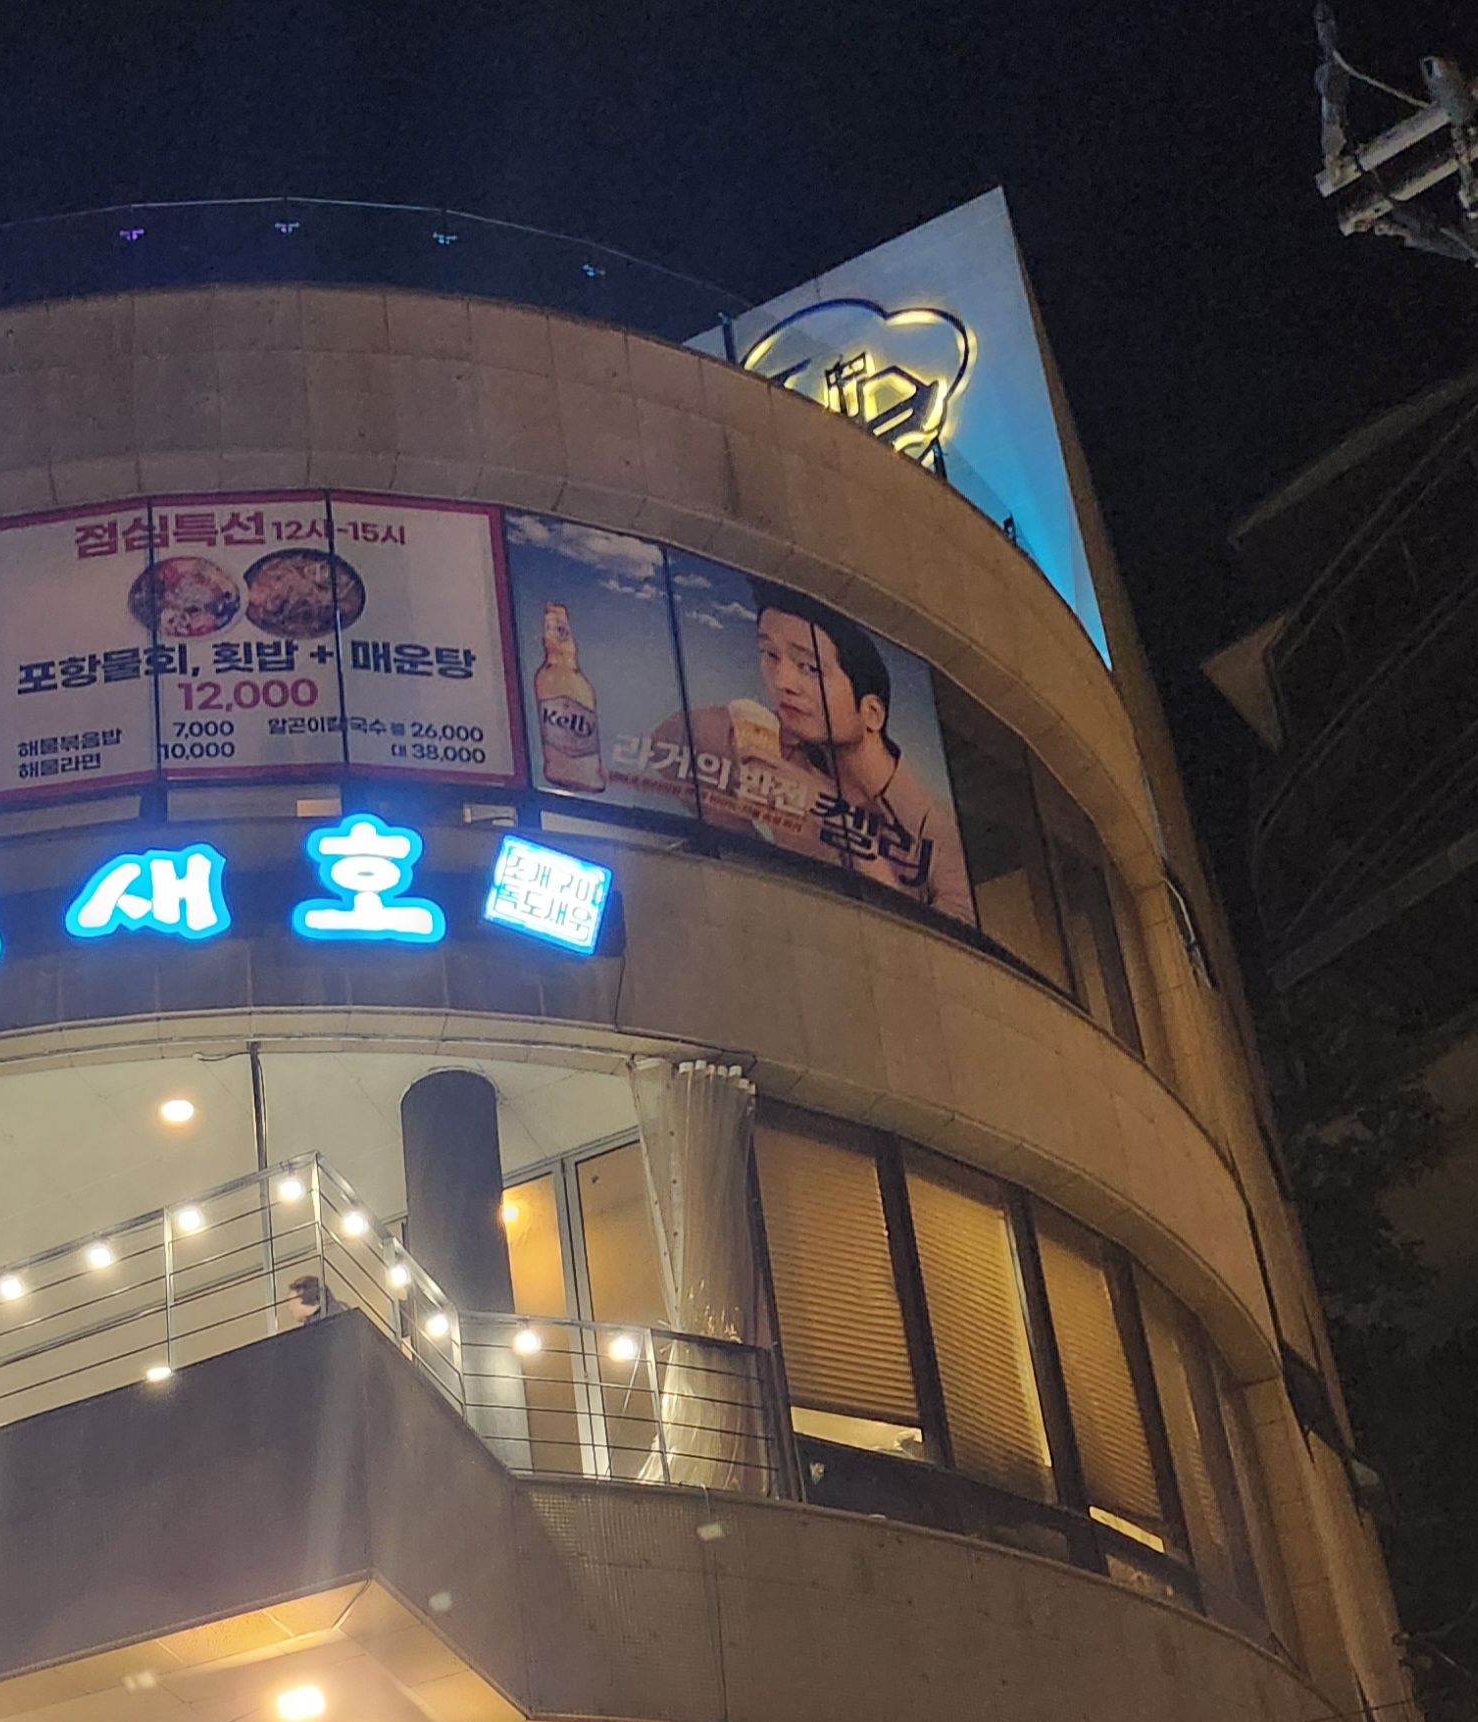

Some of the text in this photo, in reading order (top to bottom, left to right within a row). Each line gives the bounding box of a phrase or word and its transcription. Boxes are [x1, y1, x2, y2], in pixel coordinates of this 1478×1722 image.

[74, 510, 266, 559] 점심특선
[212, 641, 300, 674] 횟밥
[350, 639, 476, 681] 매운탕
[177, 677, 319, 713] 12,000
[172, 720, 235, 740] 7,000
[411, 721, 485, 743] 26,000
[542, 706, 597, 738] Kelly
[17, 752, 102, 779] 해물라면
[411, 743, 487, 764] 38,000
[611, 733, 731, 790] 라거의
[739, 763, 810, 817] 반전
[809, 791, 935, 888] 켈리
